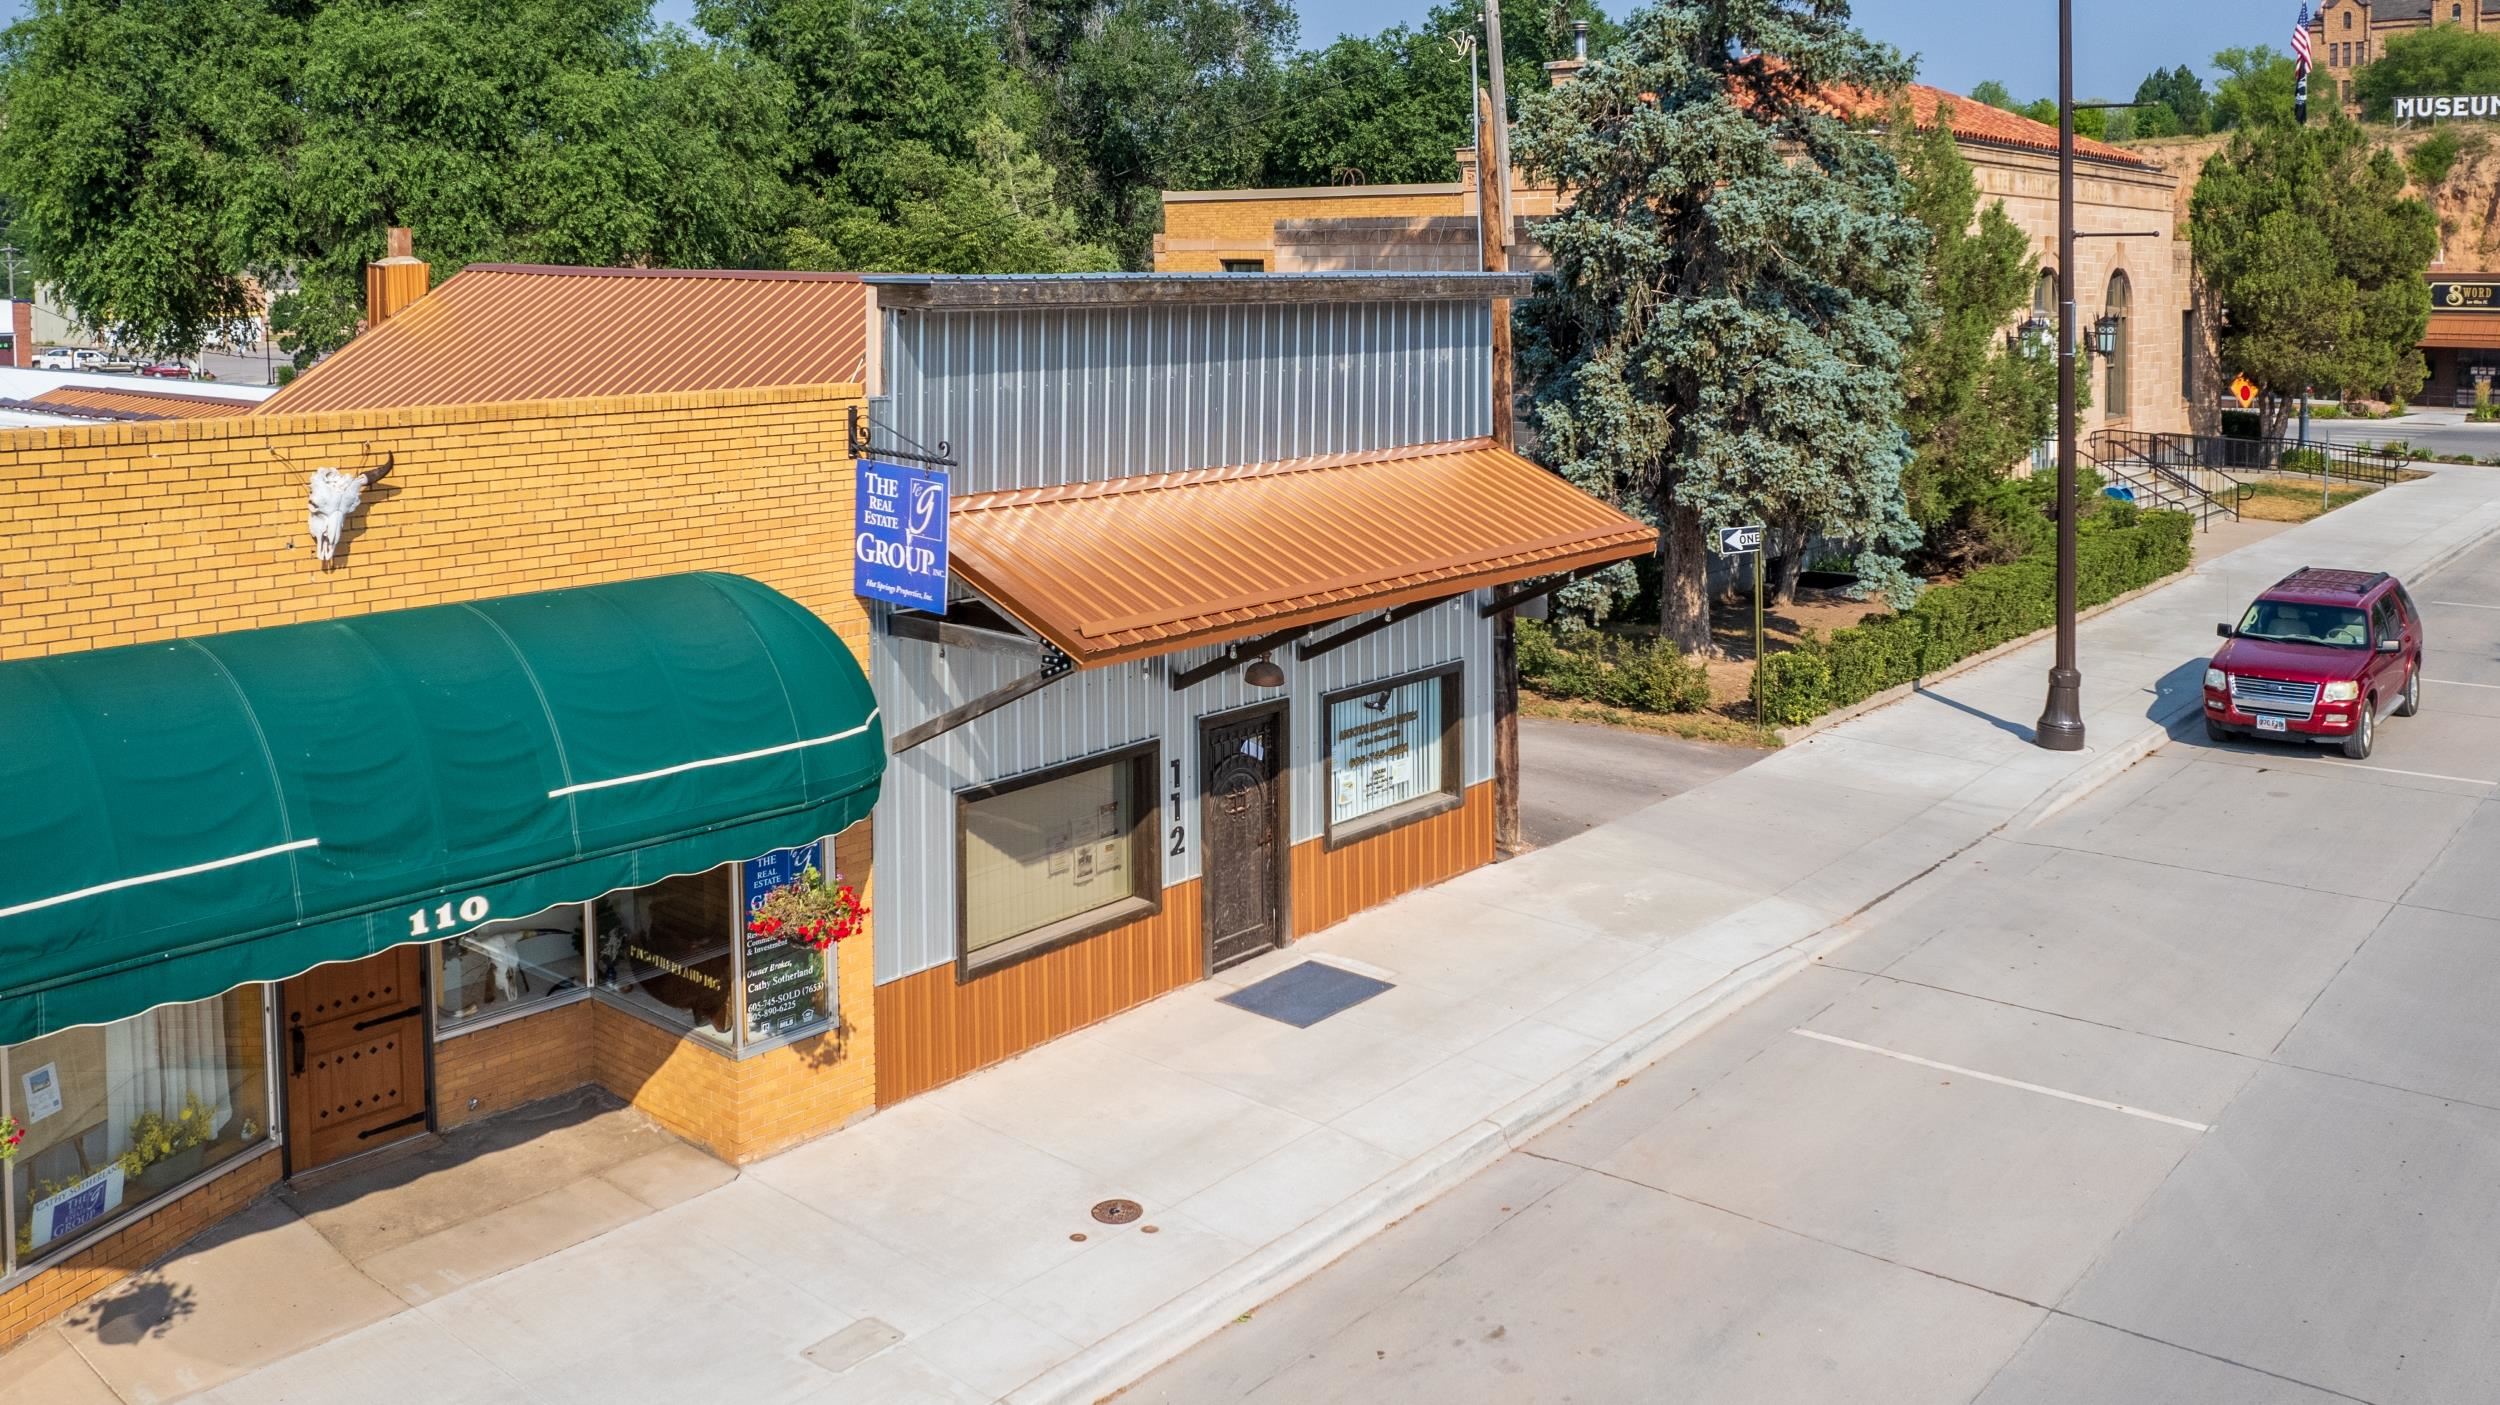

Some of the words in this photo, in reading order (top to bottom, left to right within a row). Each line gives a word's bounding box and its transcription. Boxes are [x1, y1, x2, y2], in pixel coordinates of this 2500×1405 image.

[2397, 96, 2500, 118] MUSEUM
[2446, 285, 2492, 306] SWORD
[865, 472, 899, 498] THE
[869, 495, 895, 513] REAL
[864, 510, 900, 530] ESTATE
[1739, 534, 1760, 544] ONE
[856, 532, 935, 576] GROUP
[866, 579, 877, 588] Hot
[877, 581, 896, 595] Springs
[757, 855, 777, 868] THE
[753, 875, 782, 889] ESTATE
[757, 868, 778, 880] REAL
[409, 896, 489, 936] 110
[754, 940, 788, 954] Investment
[747, 966, 769, 979] Owner
[769, 959, 793, 972] Broker,
[748, 979, 770, 994] Cathy
[772, 965, 814, 986] Sotherland
[36, 1193, 67, 1212] CATHY
[70, 1166, 118, 1193] SOTHERLAN
